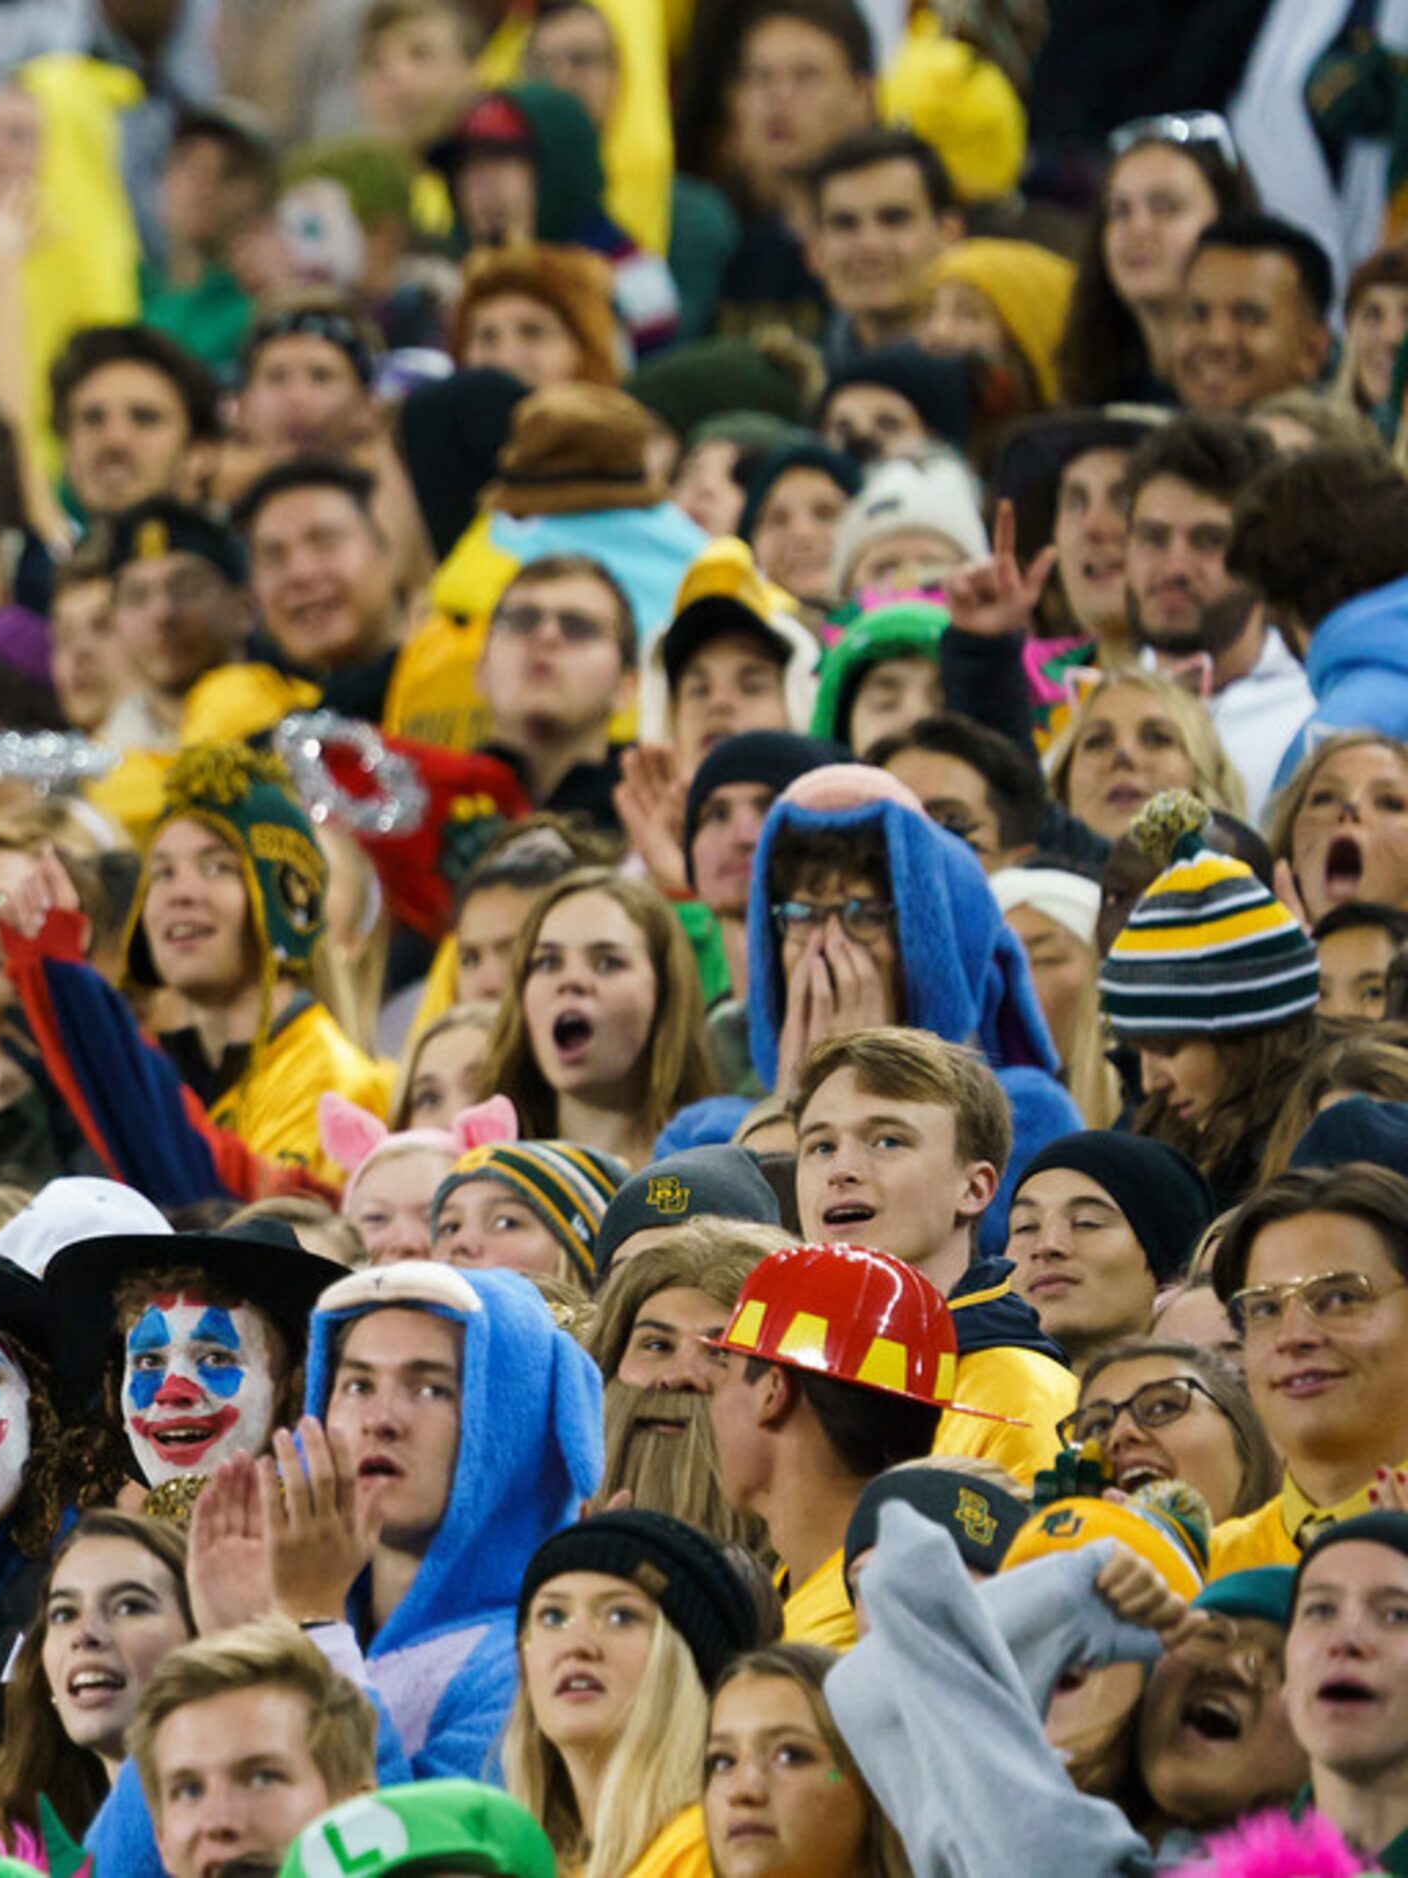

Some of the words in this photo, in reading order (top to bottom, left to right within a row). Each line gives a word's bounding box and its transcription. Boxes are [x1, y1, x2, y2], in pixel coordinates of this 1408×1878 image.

[646, 1175, 691, 1213] BU
[954, 1487, 998, 1545] BU
[322, 1820, 382, 1874] L
